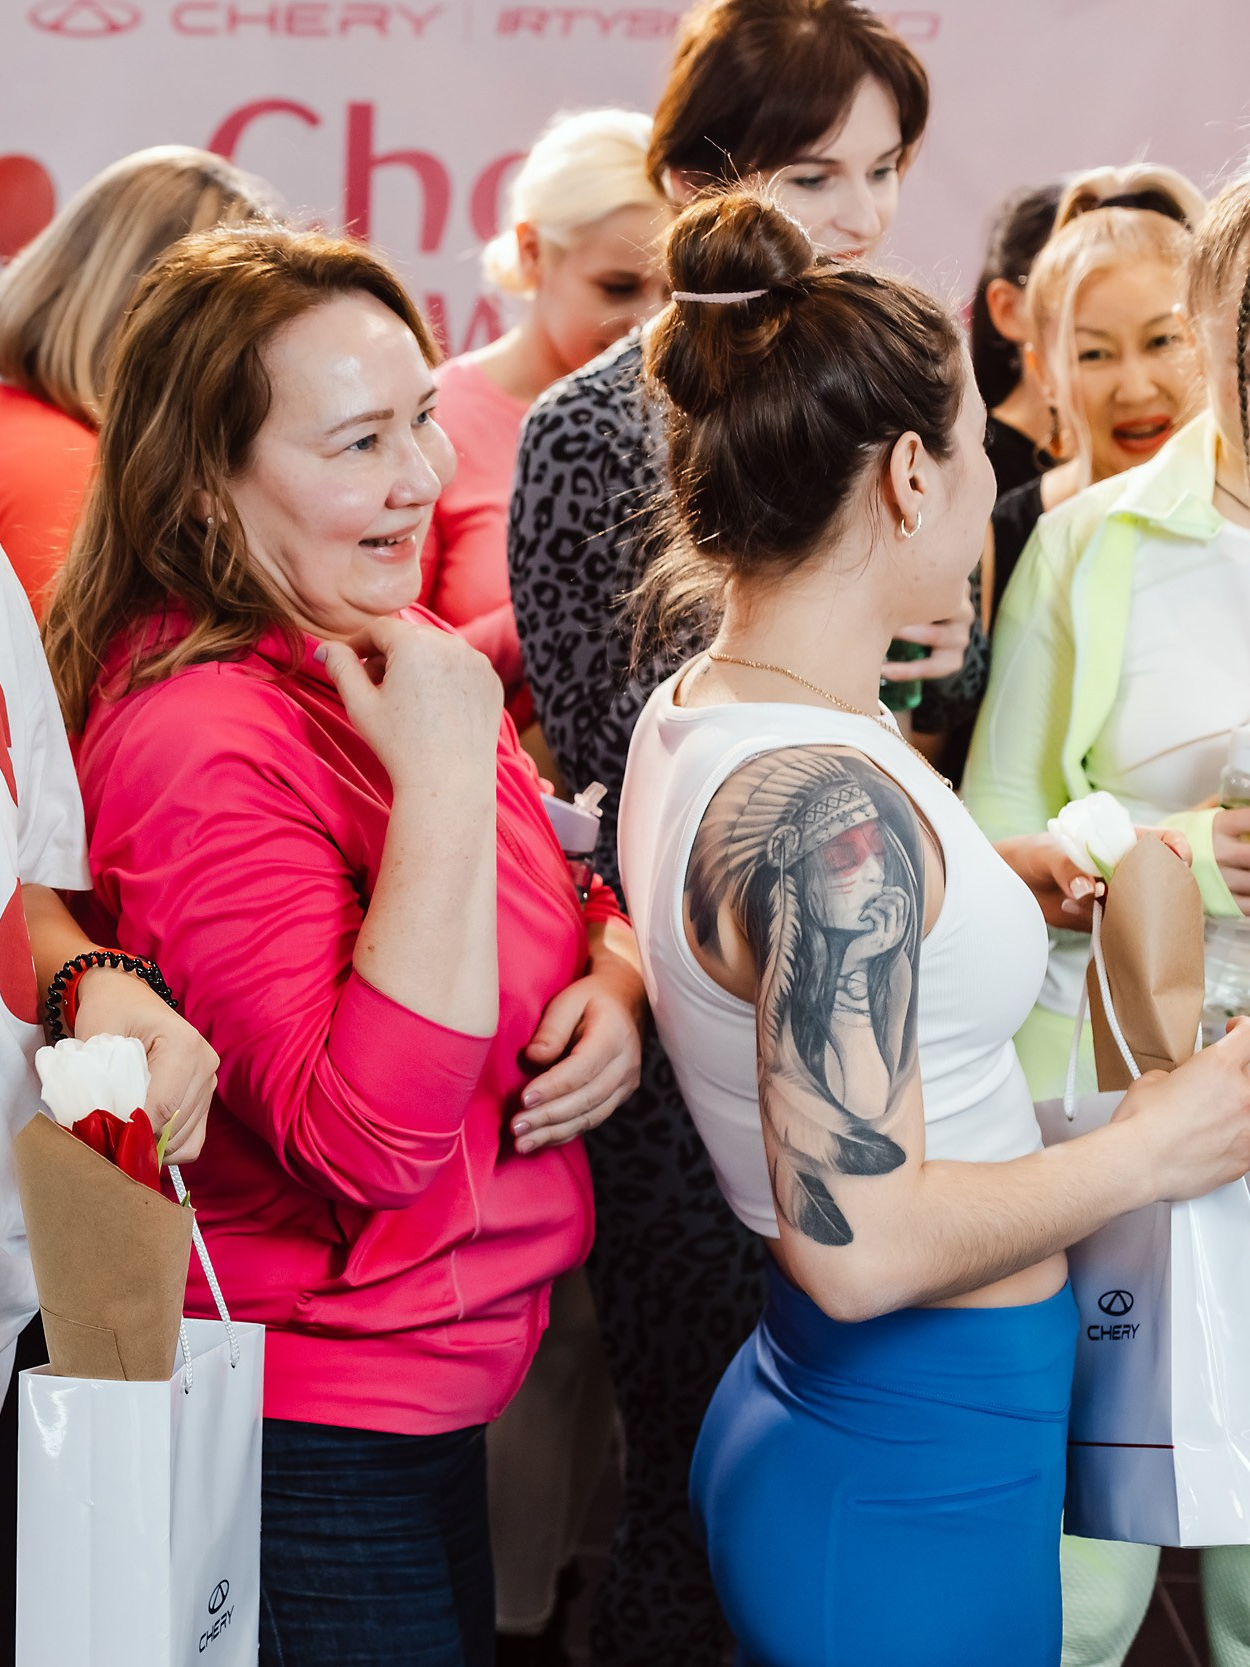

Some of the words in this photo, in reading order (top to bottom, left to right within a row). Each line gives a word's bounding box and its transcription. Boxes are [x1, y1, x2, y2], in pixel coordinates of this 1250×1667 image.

[172, 2, 444, 38] CHERY
[1087, 1323, 1141, 1341] CHERY
[198, 1605, 235, 1653] CHERY
